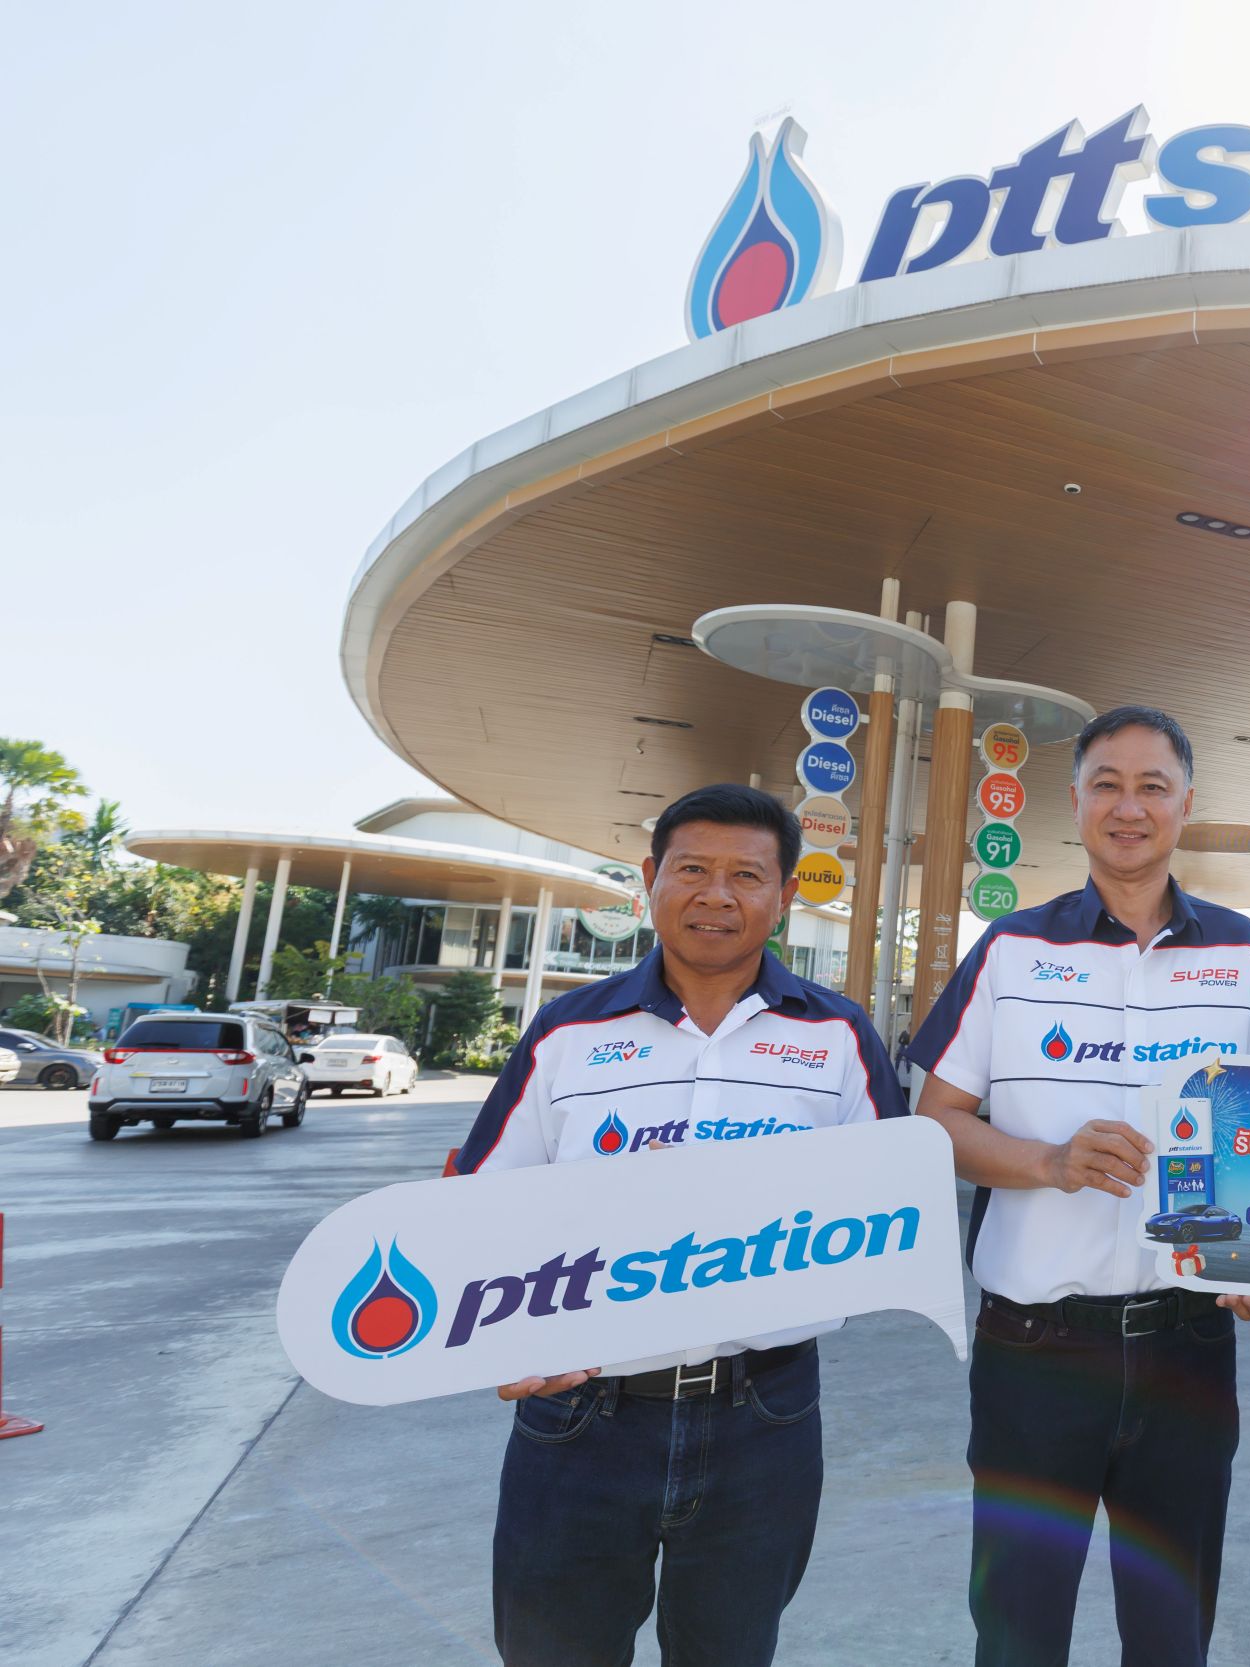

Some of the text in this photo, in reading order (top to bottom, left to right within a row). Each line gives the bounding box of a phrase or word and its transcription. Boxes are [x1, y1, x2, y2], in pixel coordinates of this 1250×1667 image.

[811, 708, 853, 726] Diesel
[992, 742, 1018, 763] 95
[807, 755, 850, 773] Diesel
[990, 783, 1017, 793] Gasohol
[989, 792, 1016, 813] 95
[802, 817, 846, 835] Diesel
[986, 833, 1013, 843] Gasohol
[986, 841, 1011, 863] 91
[798, 870, 842, 885] เบนซิน
[978, 889, 1013, 909] E20
[1030, 959, 1075, 973] XTRA
[1033, 969, 1091, 983] SAVE
[1170, 968, 1239, 983] SUPER
[586, 1040, 636, 1061] XTRA
[587, 1045, 653, 1066] SAVE
[750, 1042, 829, 1062] SUPER
[1073, 1040, 1126, 1063] ptt
[780, 1056, 826, 1069] POWER
[628, 1118, 690, 1152] ptt
